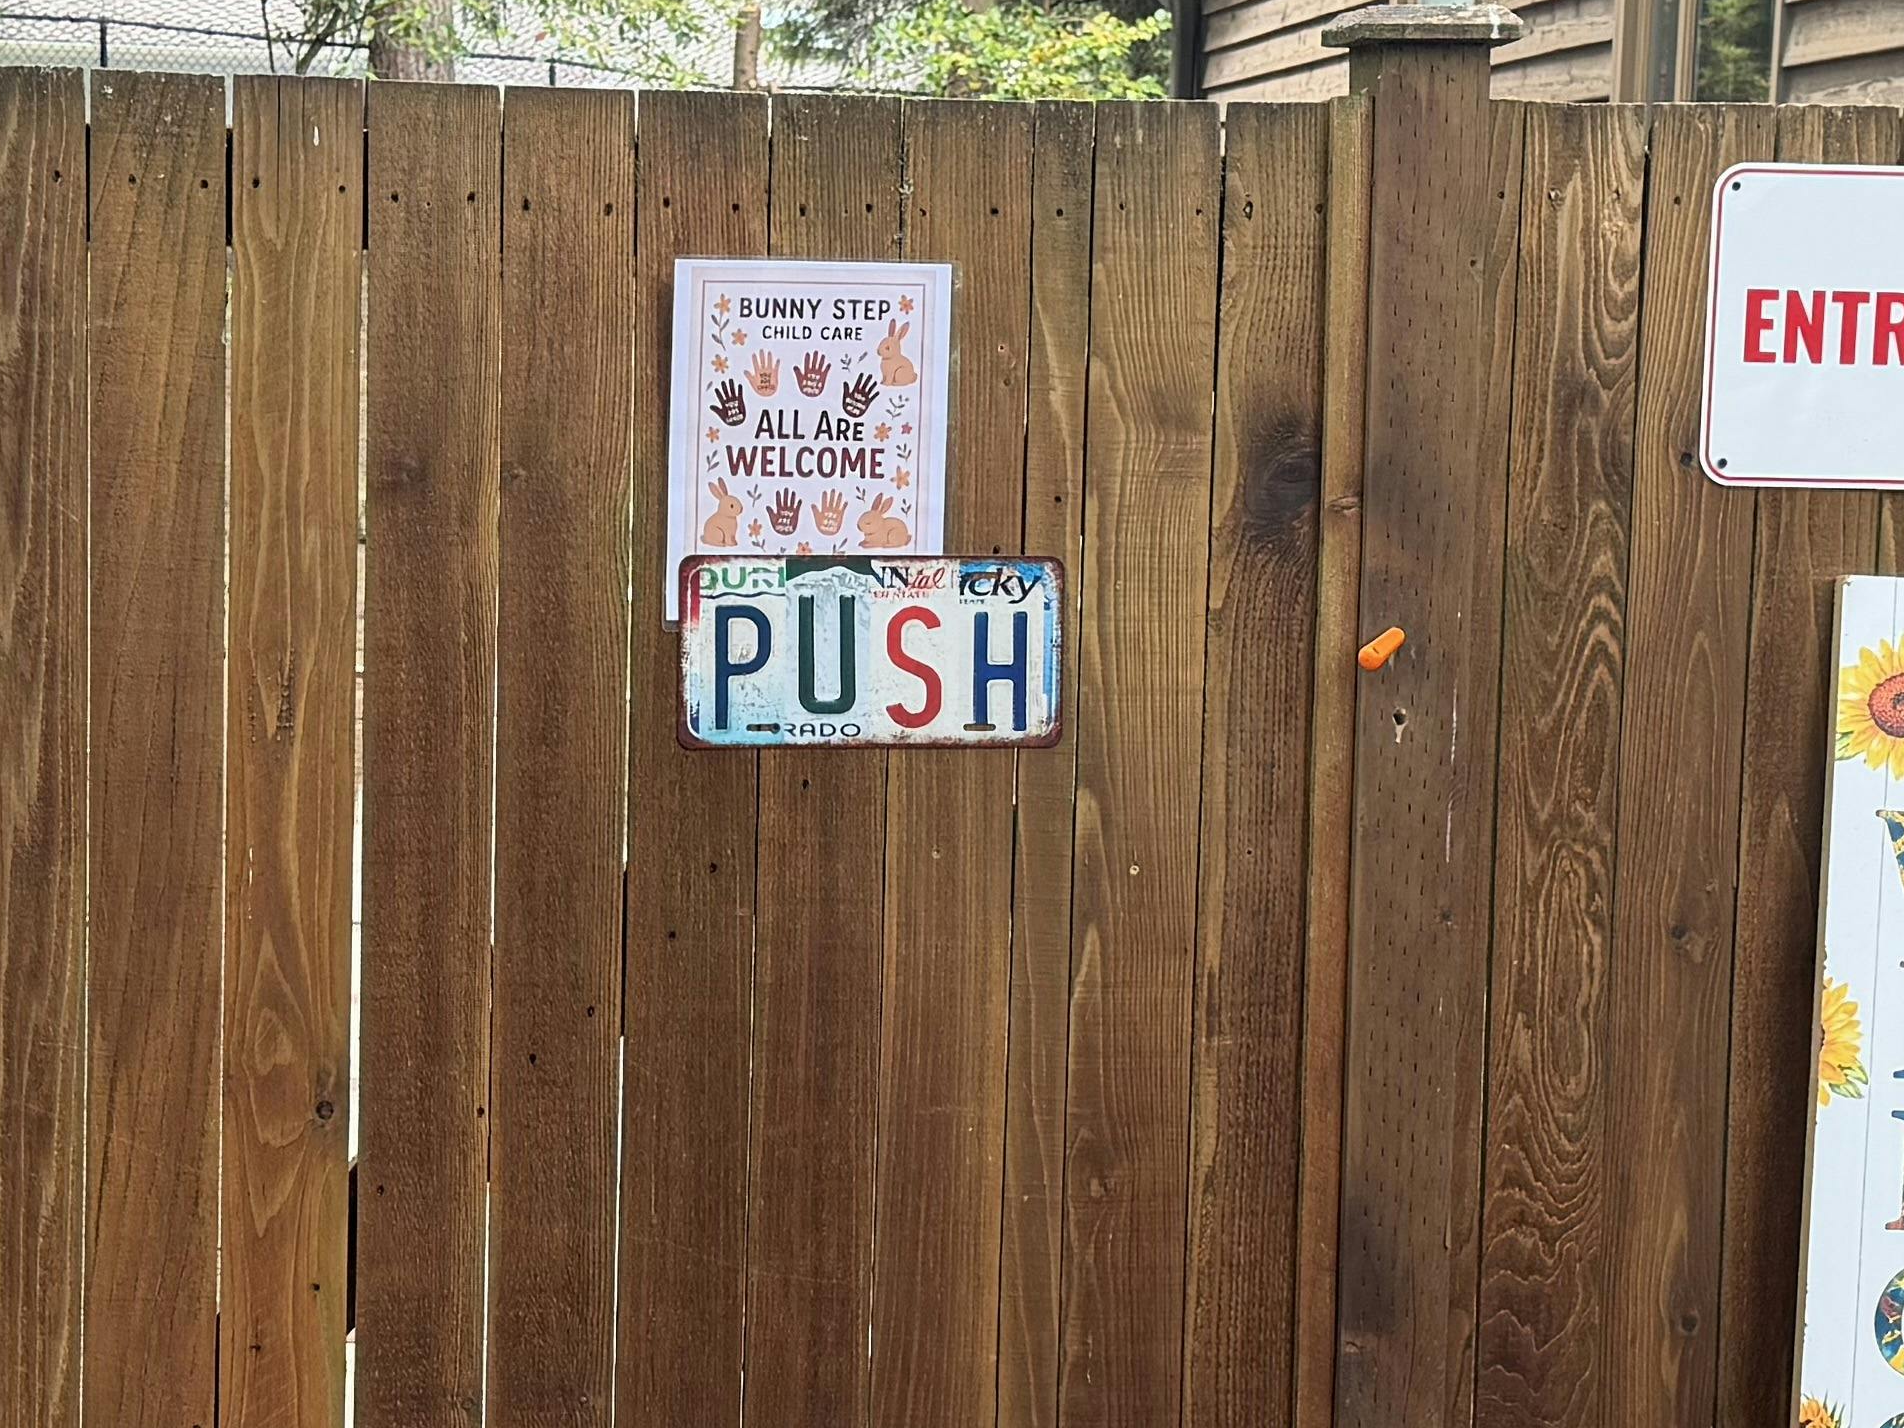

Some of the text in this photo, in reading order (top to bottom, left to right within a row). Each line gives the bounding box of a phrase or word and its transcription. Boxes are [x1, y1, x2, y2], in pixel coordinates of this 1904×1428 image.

[739, 297, 891, 321] BUNNY STEP
[762, 325, 863, 341] CHILD CARE
[755, 409, 805, 440] ALL
[725, 445, 885, 479] WELCOME
[714, 594, 1028, 732] PUSH
